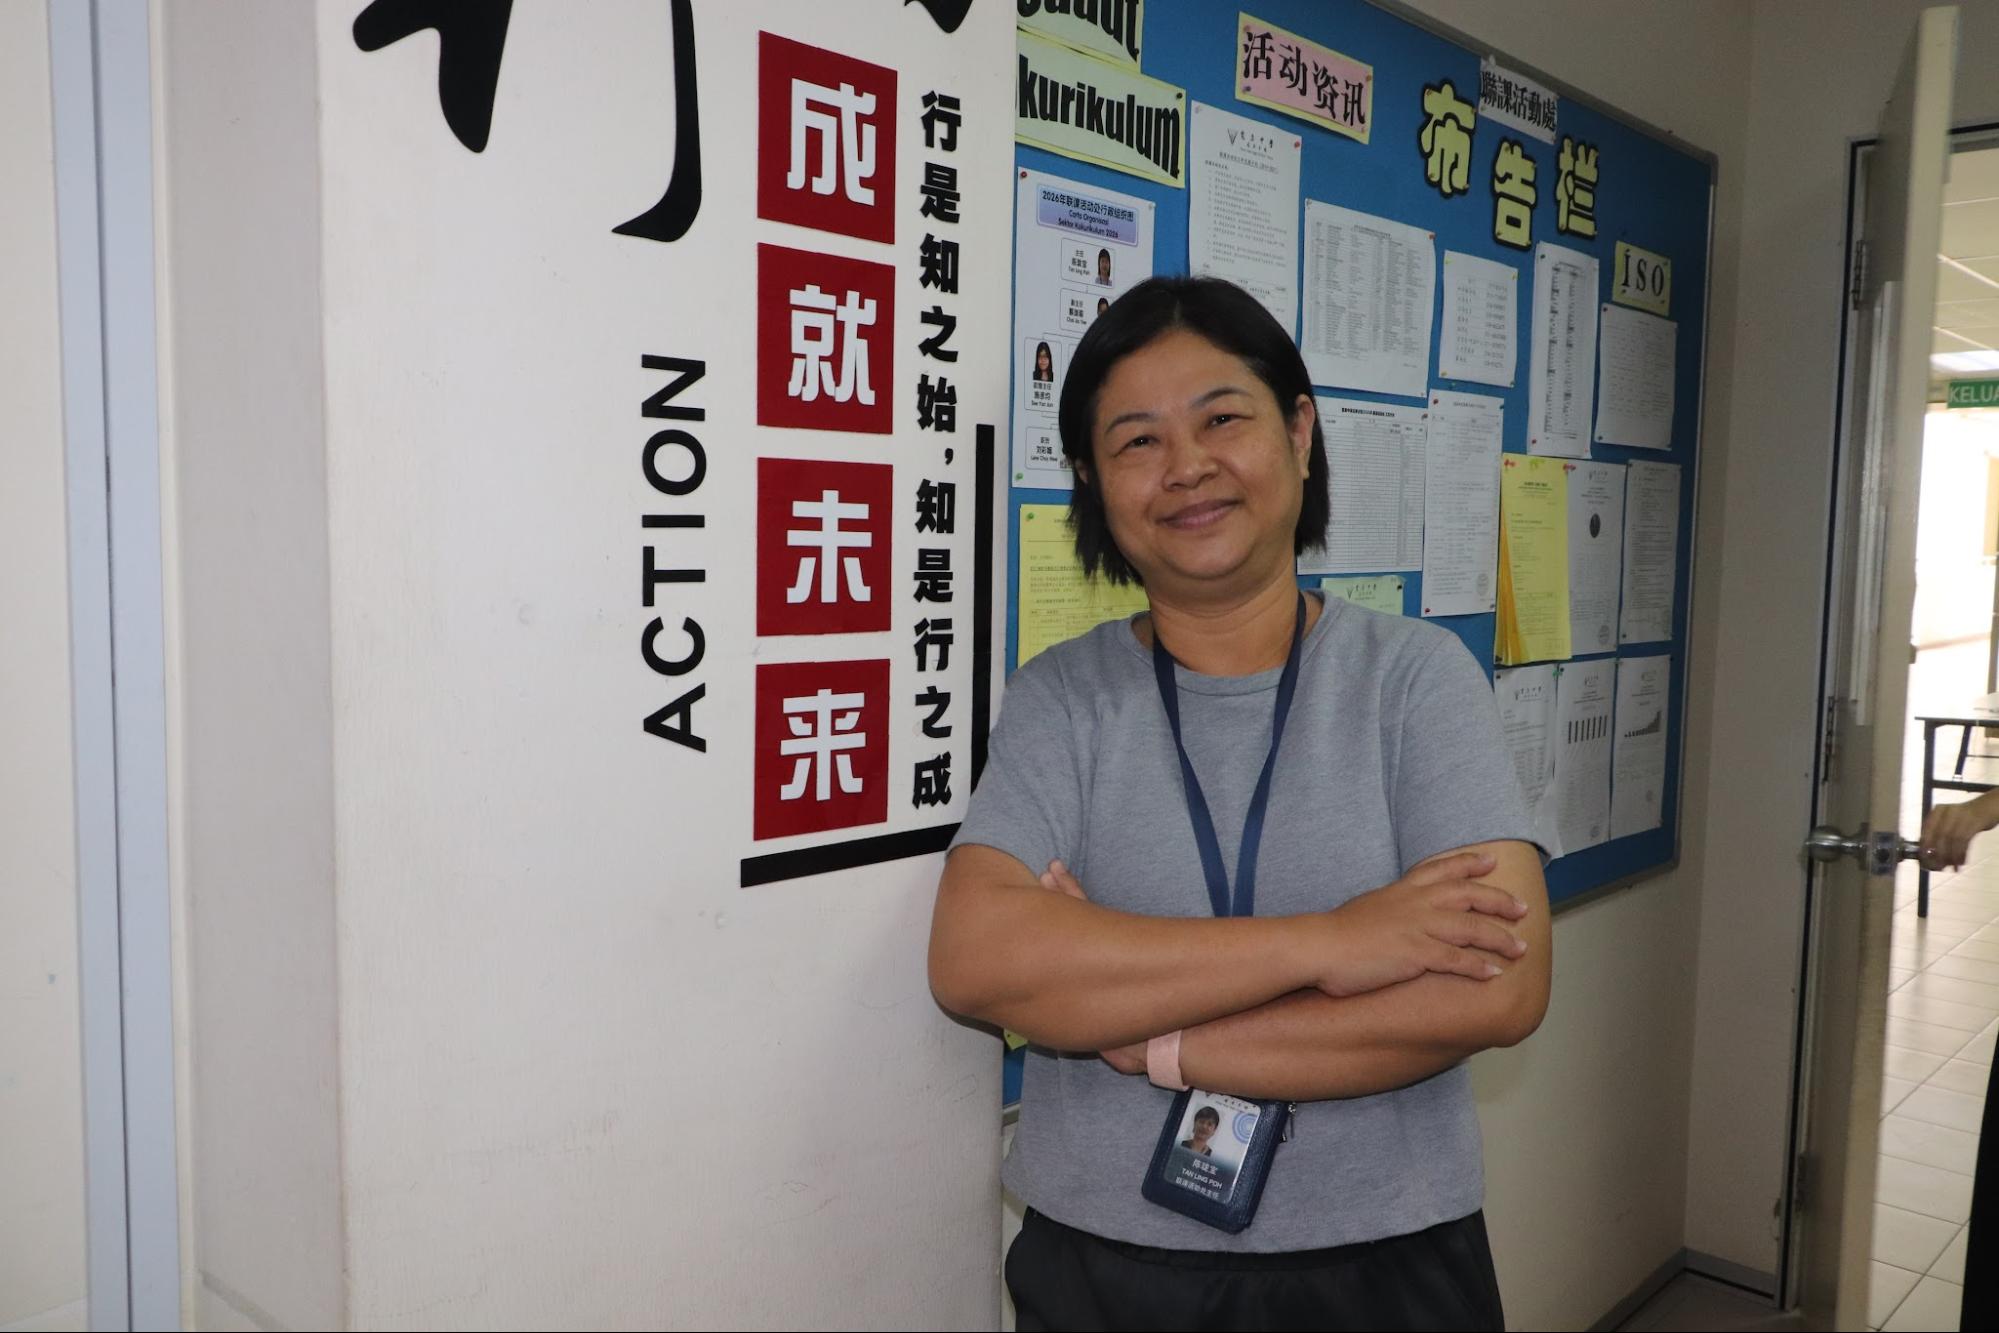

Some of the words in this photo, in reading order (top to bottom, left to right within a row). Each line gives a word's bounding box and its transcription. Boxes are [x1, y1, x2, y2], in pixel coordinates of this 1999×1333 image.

[1016, 53, 1181, 180] kurikulum
[1243, 31, 1366, 127] 活动资讯
[1480, 69, 1557, 132] 聯課活動處
[1621, 249, 1665, 297] ISO
[780, 78, 877, 802] 成就未来
[641, 354, 707, 753] ACTION
[1181, 1167, 1195, 1178] TAN
[1194, 1171, 1208, 1184] LING
[1208, 1177, 1223, 1190] POH
